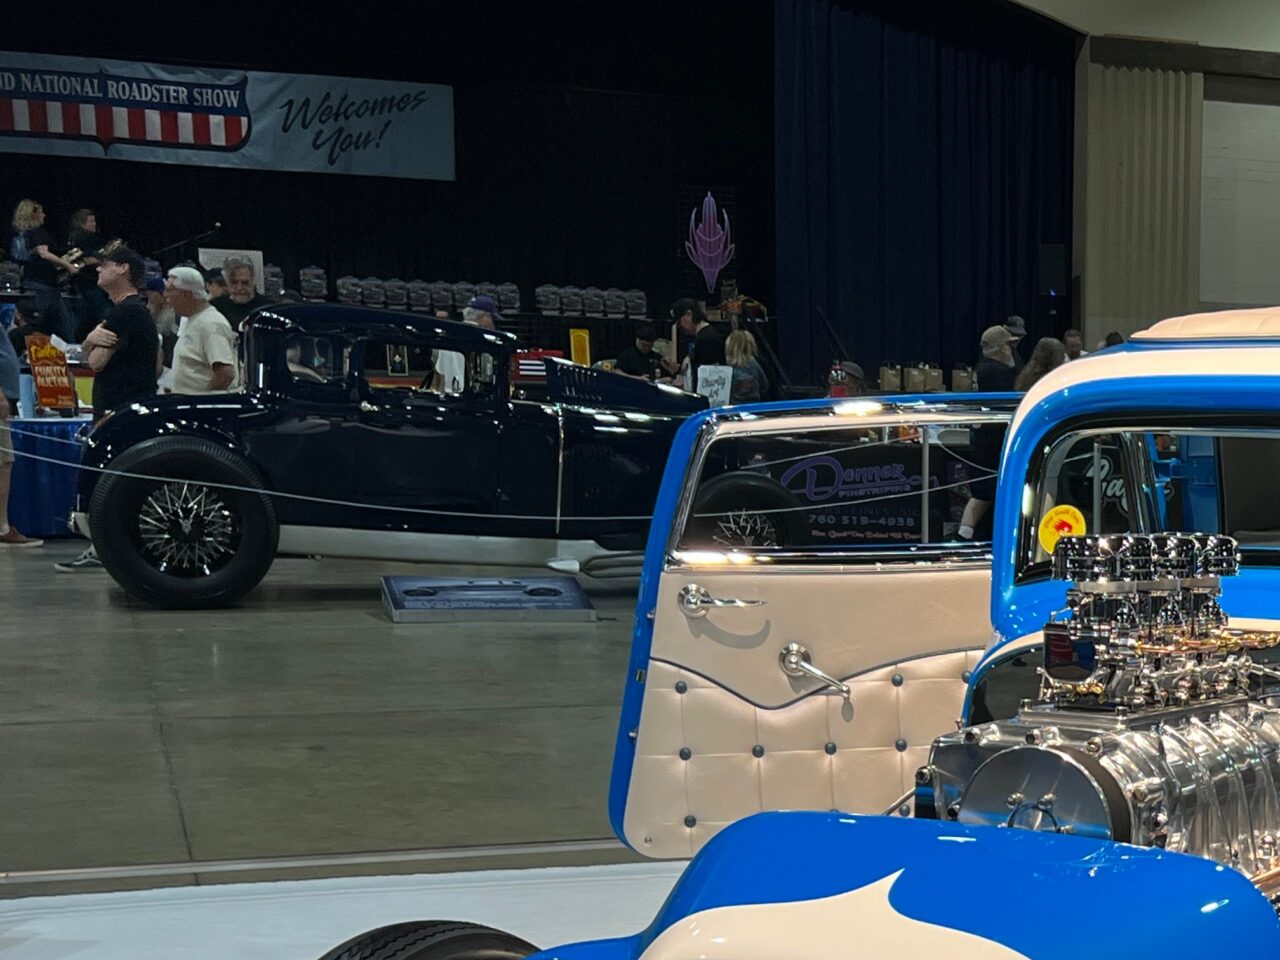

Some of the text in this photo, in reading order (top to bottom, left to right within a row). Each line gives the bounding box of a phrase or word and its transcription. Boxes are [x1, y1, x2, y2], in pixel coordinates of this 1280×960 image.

[19, 73, 103, 98] NATIONAL
[107, 80, 189, 105] ROADSTER
[192, 88, 240, 109] SHOW
[278, 90, 429, 133] Welcomes
[312, 120, 392, 166] You!
[808, 514, 836, 524] 760
